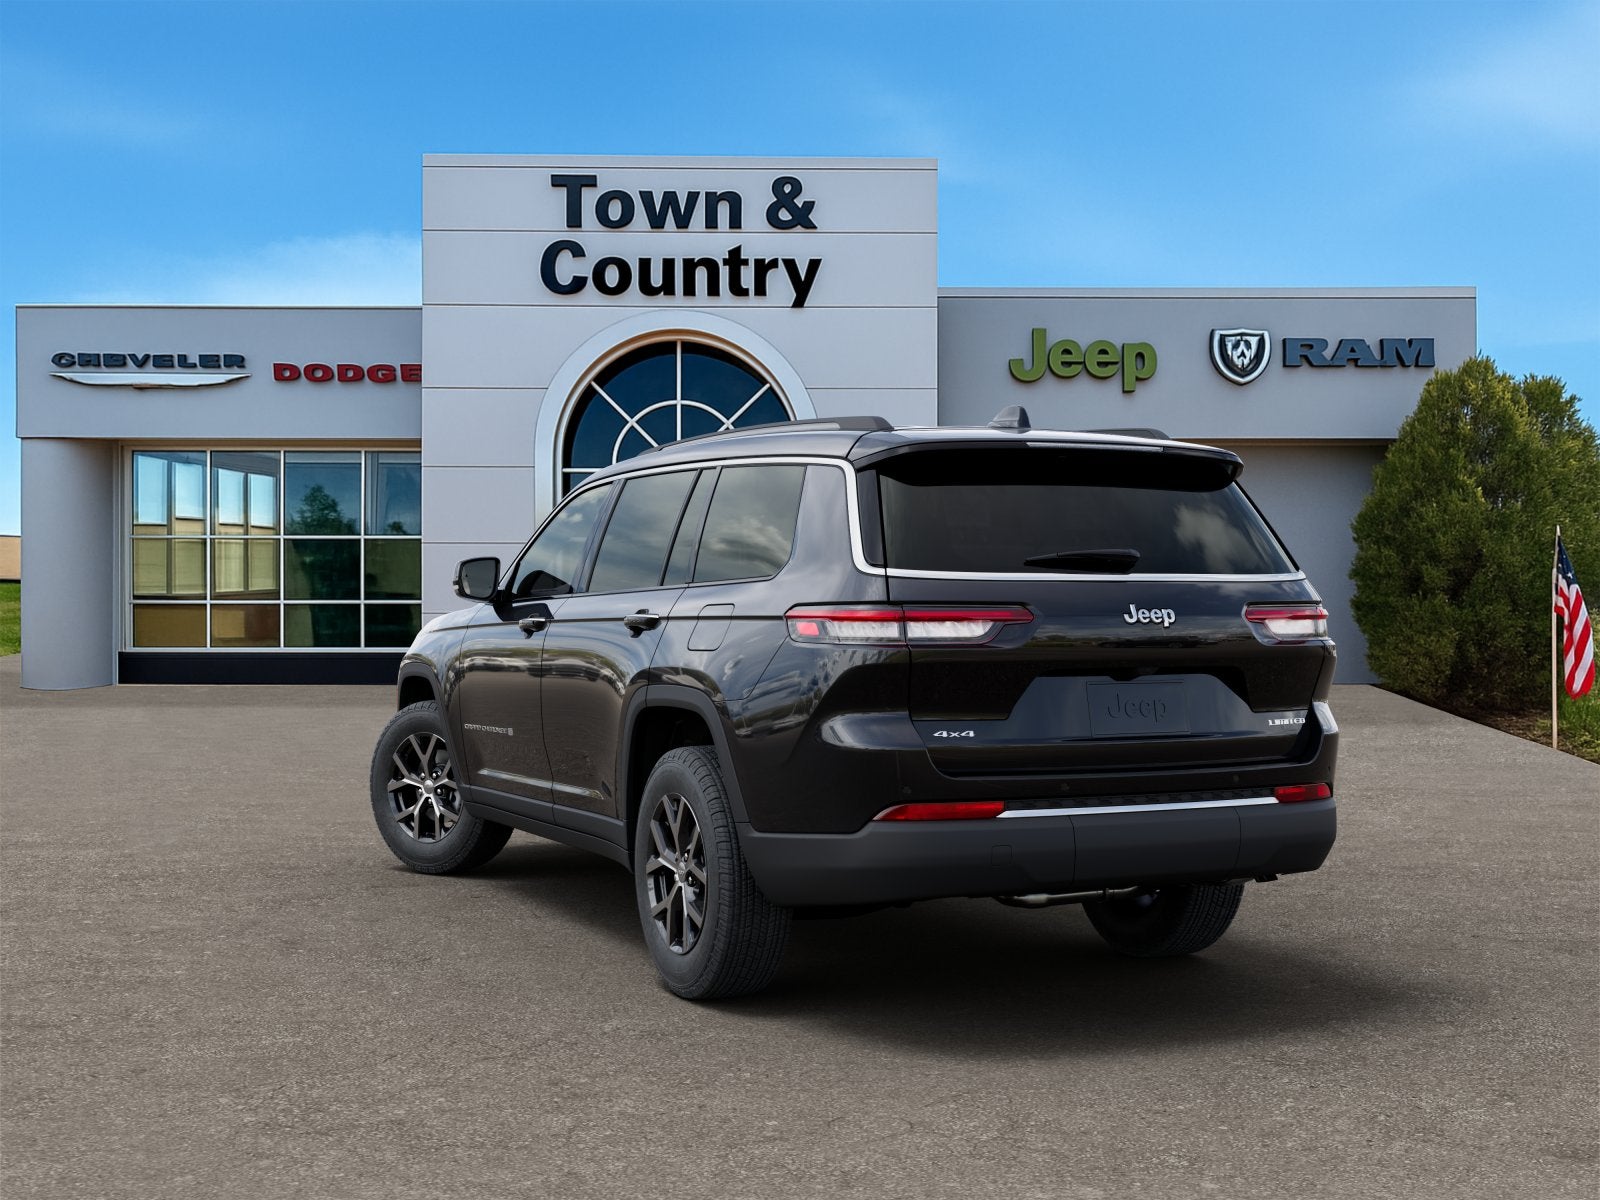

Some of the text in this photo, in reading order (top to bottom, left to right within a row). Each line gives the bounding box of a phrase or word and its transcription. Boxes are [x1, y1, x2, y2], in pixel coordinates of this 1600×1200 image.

[550, 174, 818, 230] Town &
[540, 239, 822, 308] Country
[1008, 328, 1158, 394] Jeep
[1282, 337, 1436, 368] RAM
[273, 363, 422, 383] DODGE
[1123, 603, 1176, 627] Jeep
[1106, 691, 1166, 723] Jeep
